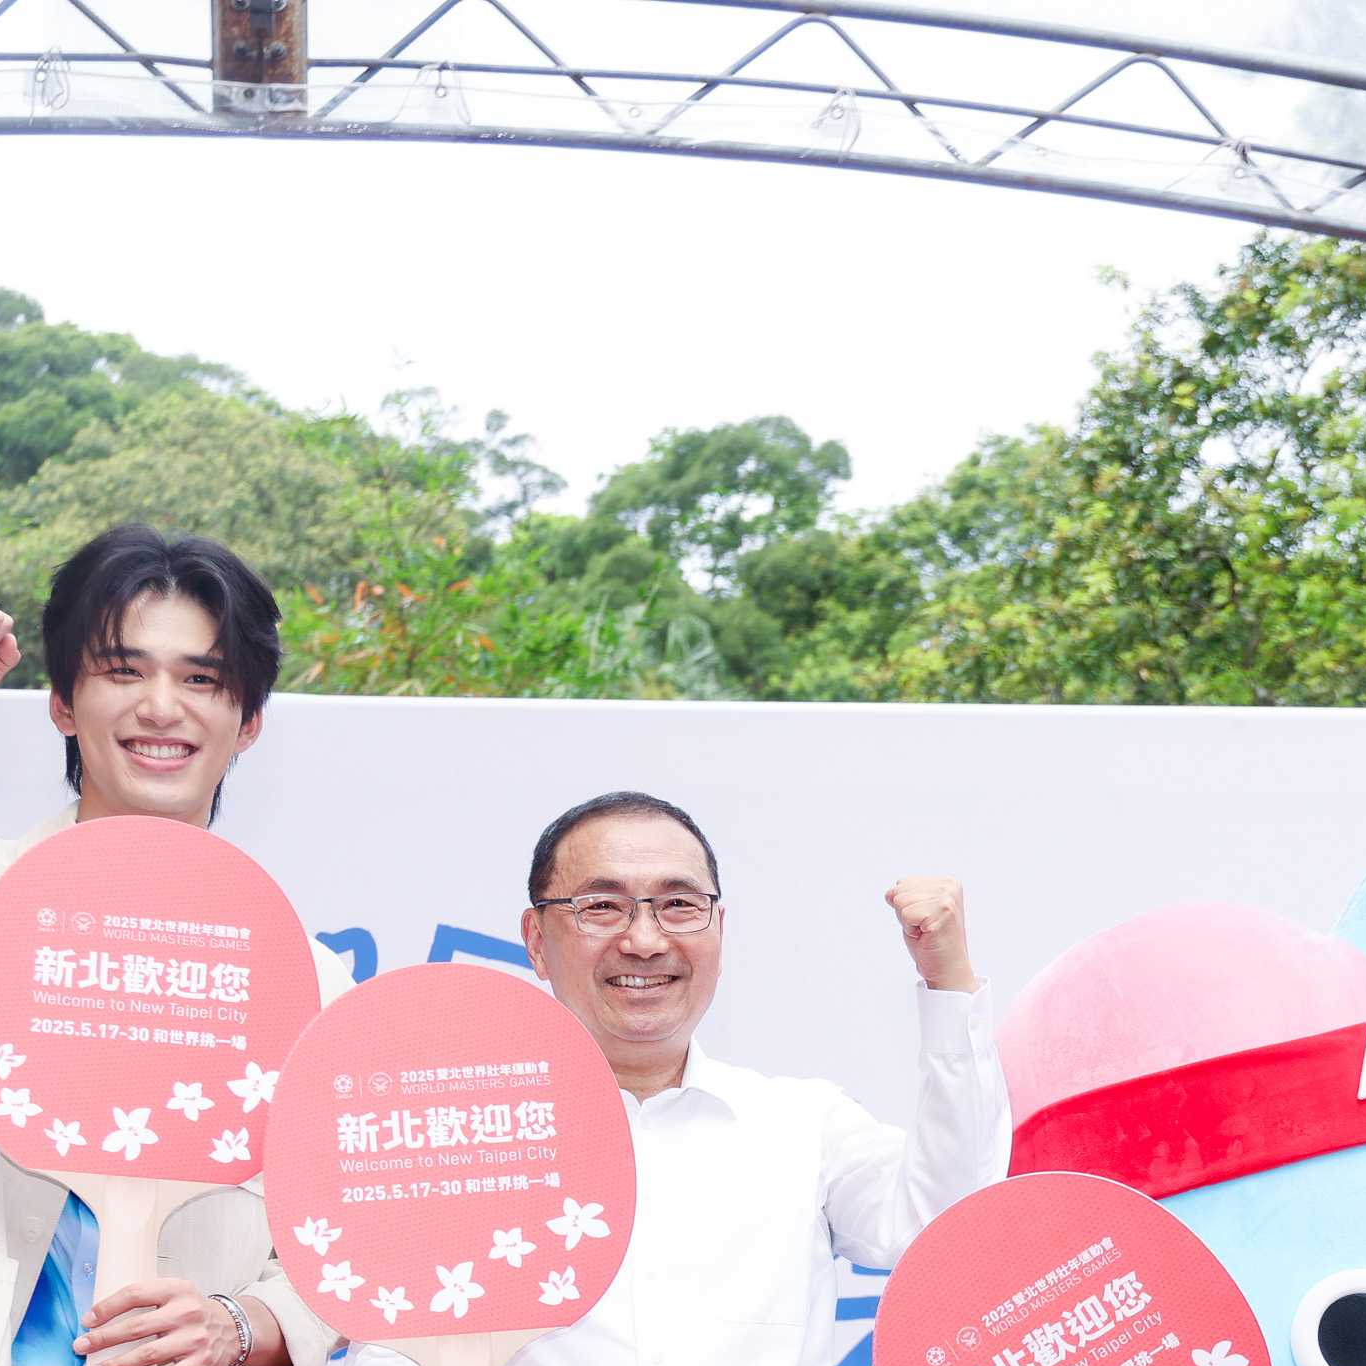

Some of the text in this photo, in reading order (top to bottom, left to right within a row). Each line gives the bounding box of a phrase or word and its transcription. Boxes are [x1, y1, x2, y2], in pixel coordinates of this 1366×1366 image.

[103, 928, 251, 952] WORLD MASTERS GAMES
[33, 946, 251, 1003] 新北歡迎您
[33, 990, 248, 1025] Welcome to New Taipei City
[401, 1082, 445, 1095] WORLD
[449, 1079, 506, 1093] MASTERS
[509, 1075, 551, 1088] GAMES
[336, 1100, 557, 1154] 新北歡迎您
[339, 1145, 557, 1173] Welcome to New Taipei City
[988, 1248, 1123, 1337] WORLD MASTERS GAMES
[1088, 1328, 1133, 1362] Taipei
[1132, 1311, 1163, 1335] City
